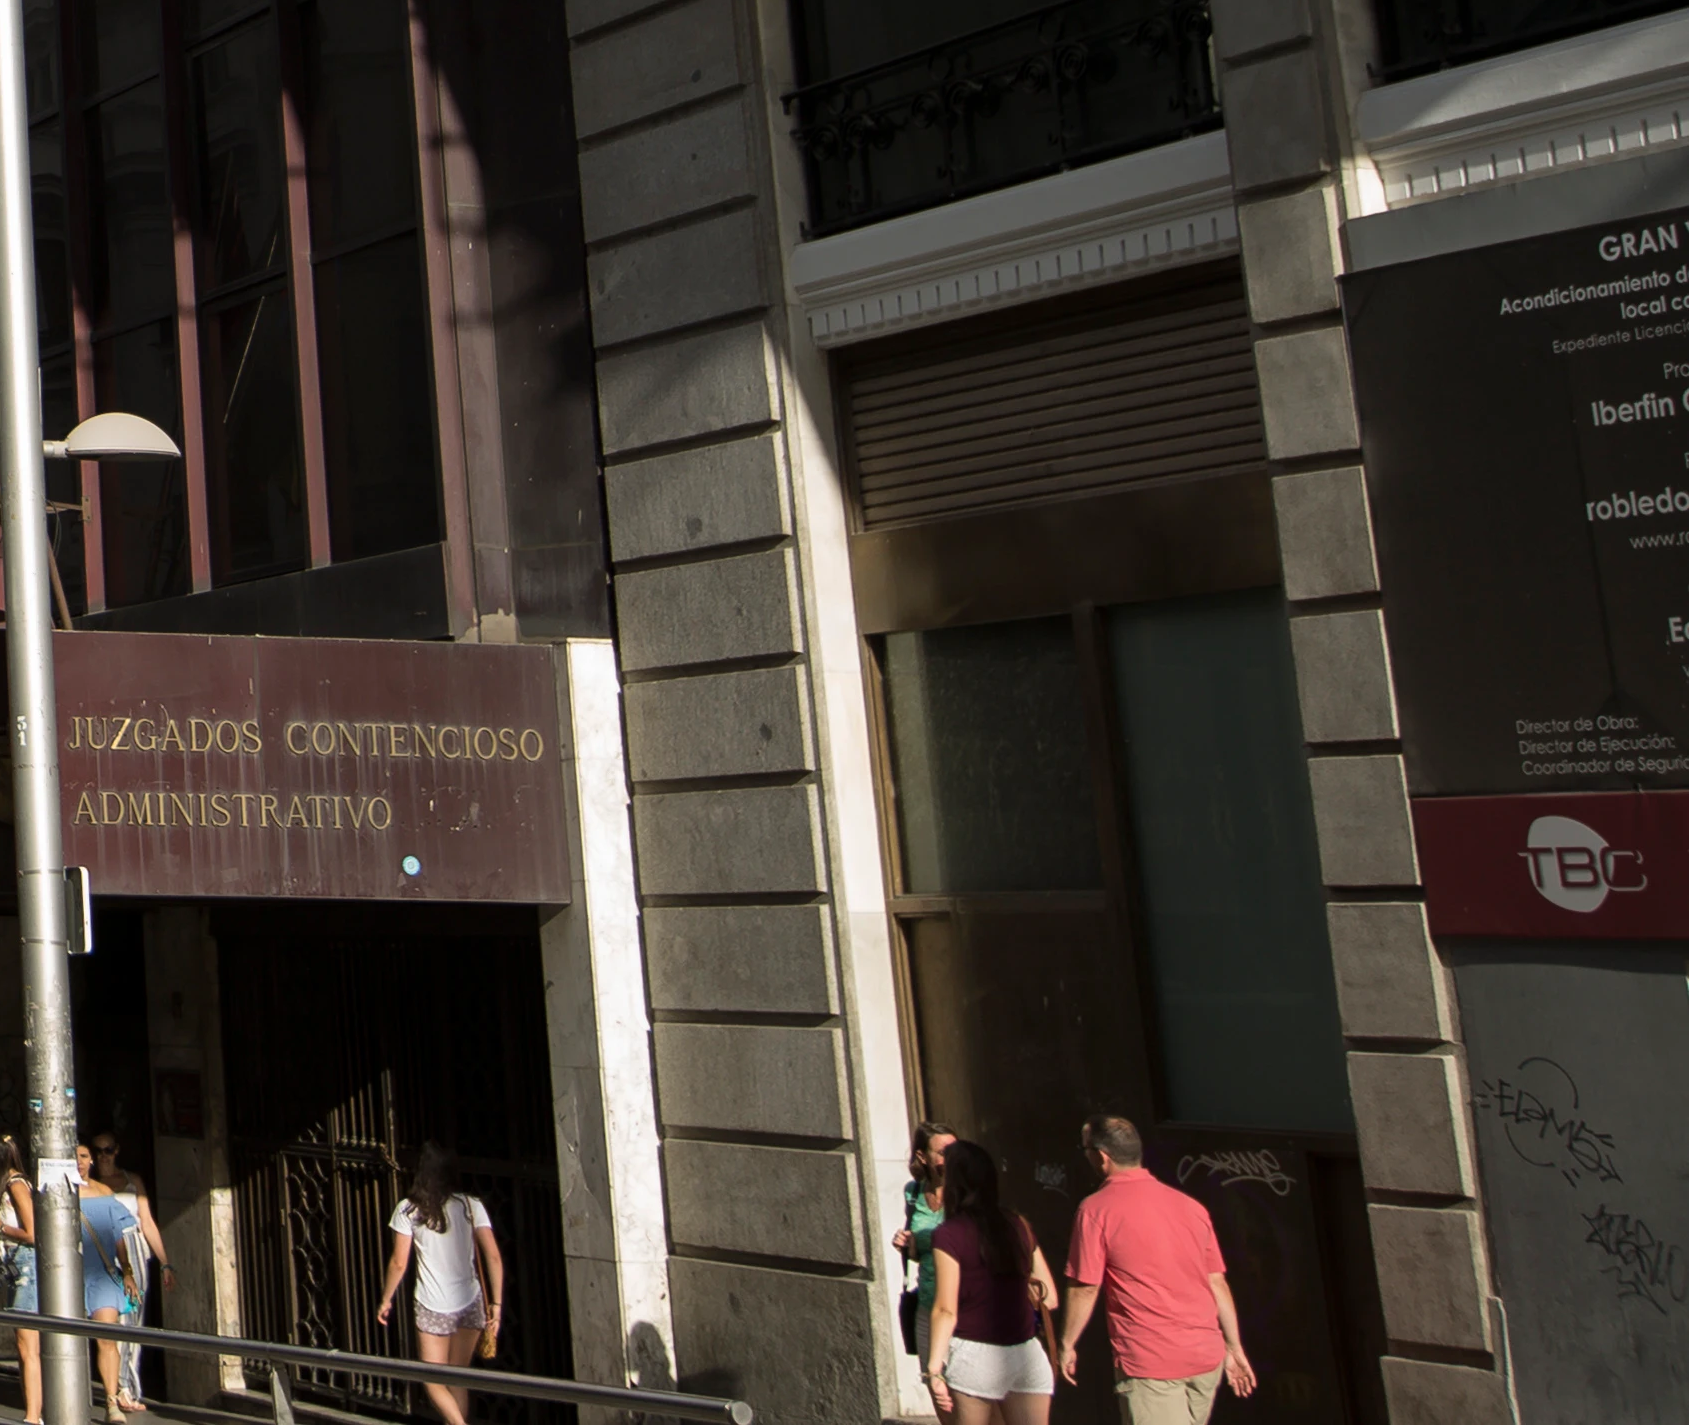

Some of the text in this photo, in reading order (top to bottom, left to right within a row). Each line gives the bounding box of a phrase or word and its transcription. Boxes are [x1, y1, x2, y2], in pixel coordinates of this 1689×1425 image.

[1598, 223, 1679, 262] GRAN
[1499, 264, 1689, 316] Acondicionamiento d
[1620, 294, 1667, 319] local
[1552, 319, 1689, 354] Expediente Licenci
[1591, 392, 1675, 426] Iberfin
[1629, 531, 1689, 549] www.r
[67, 716, 545, 762] JUZGADOS CONTENCIOSO
[1515, 715, 1639, 734] Director de Obra:
[1518, 732, 1677, 754] Director de Ejecución:
[1521, 759, 1611, 775] Coordinador
[1614, 758, 1635, 772] de
[73, 791, 393, 830] ADMINISTRATIVO
[1517, 846, 1648, 892] TBC
